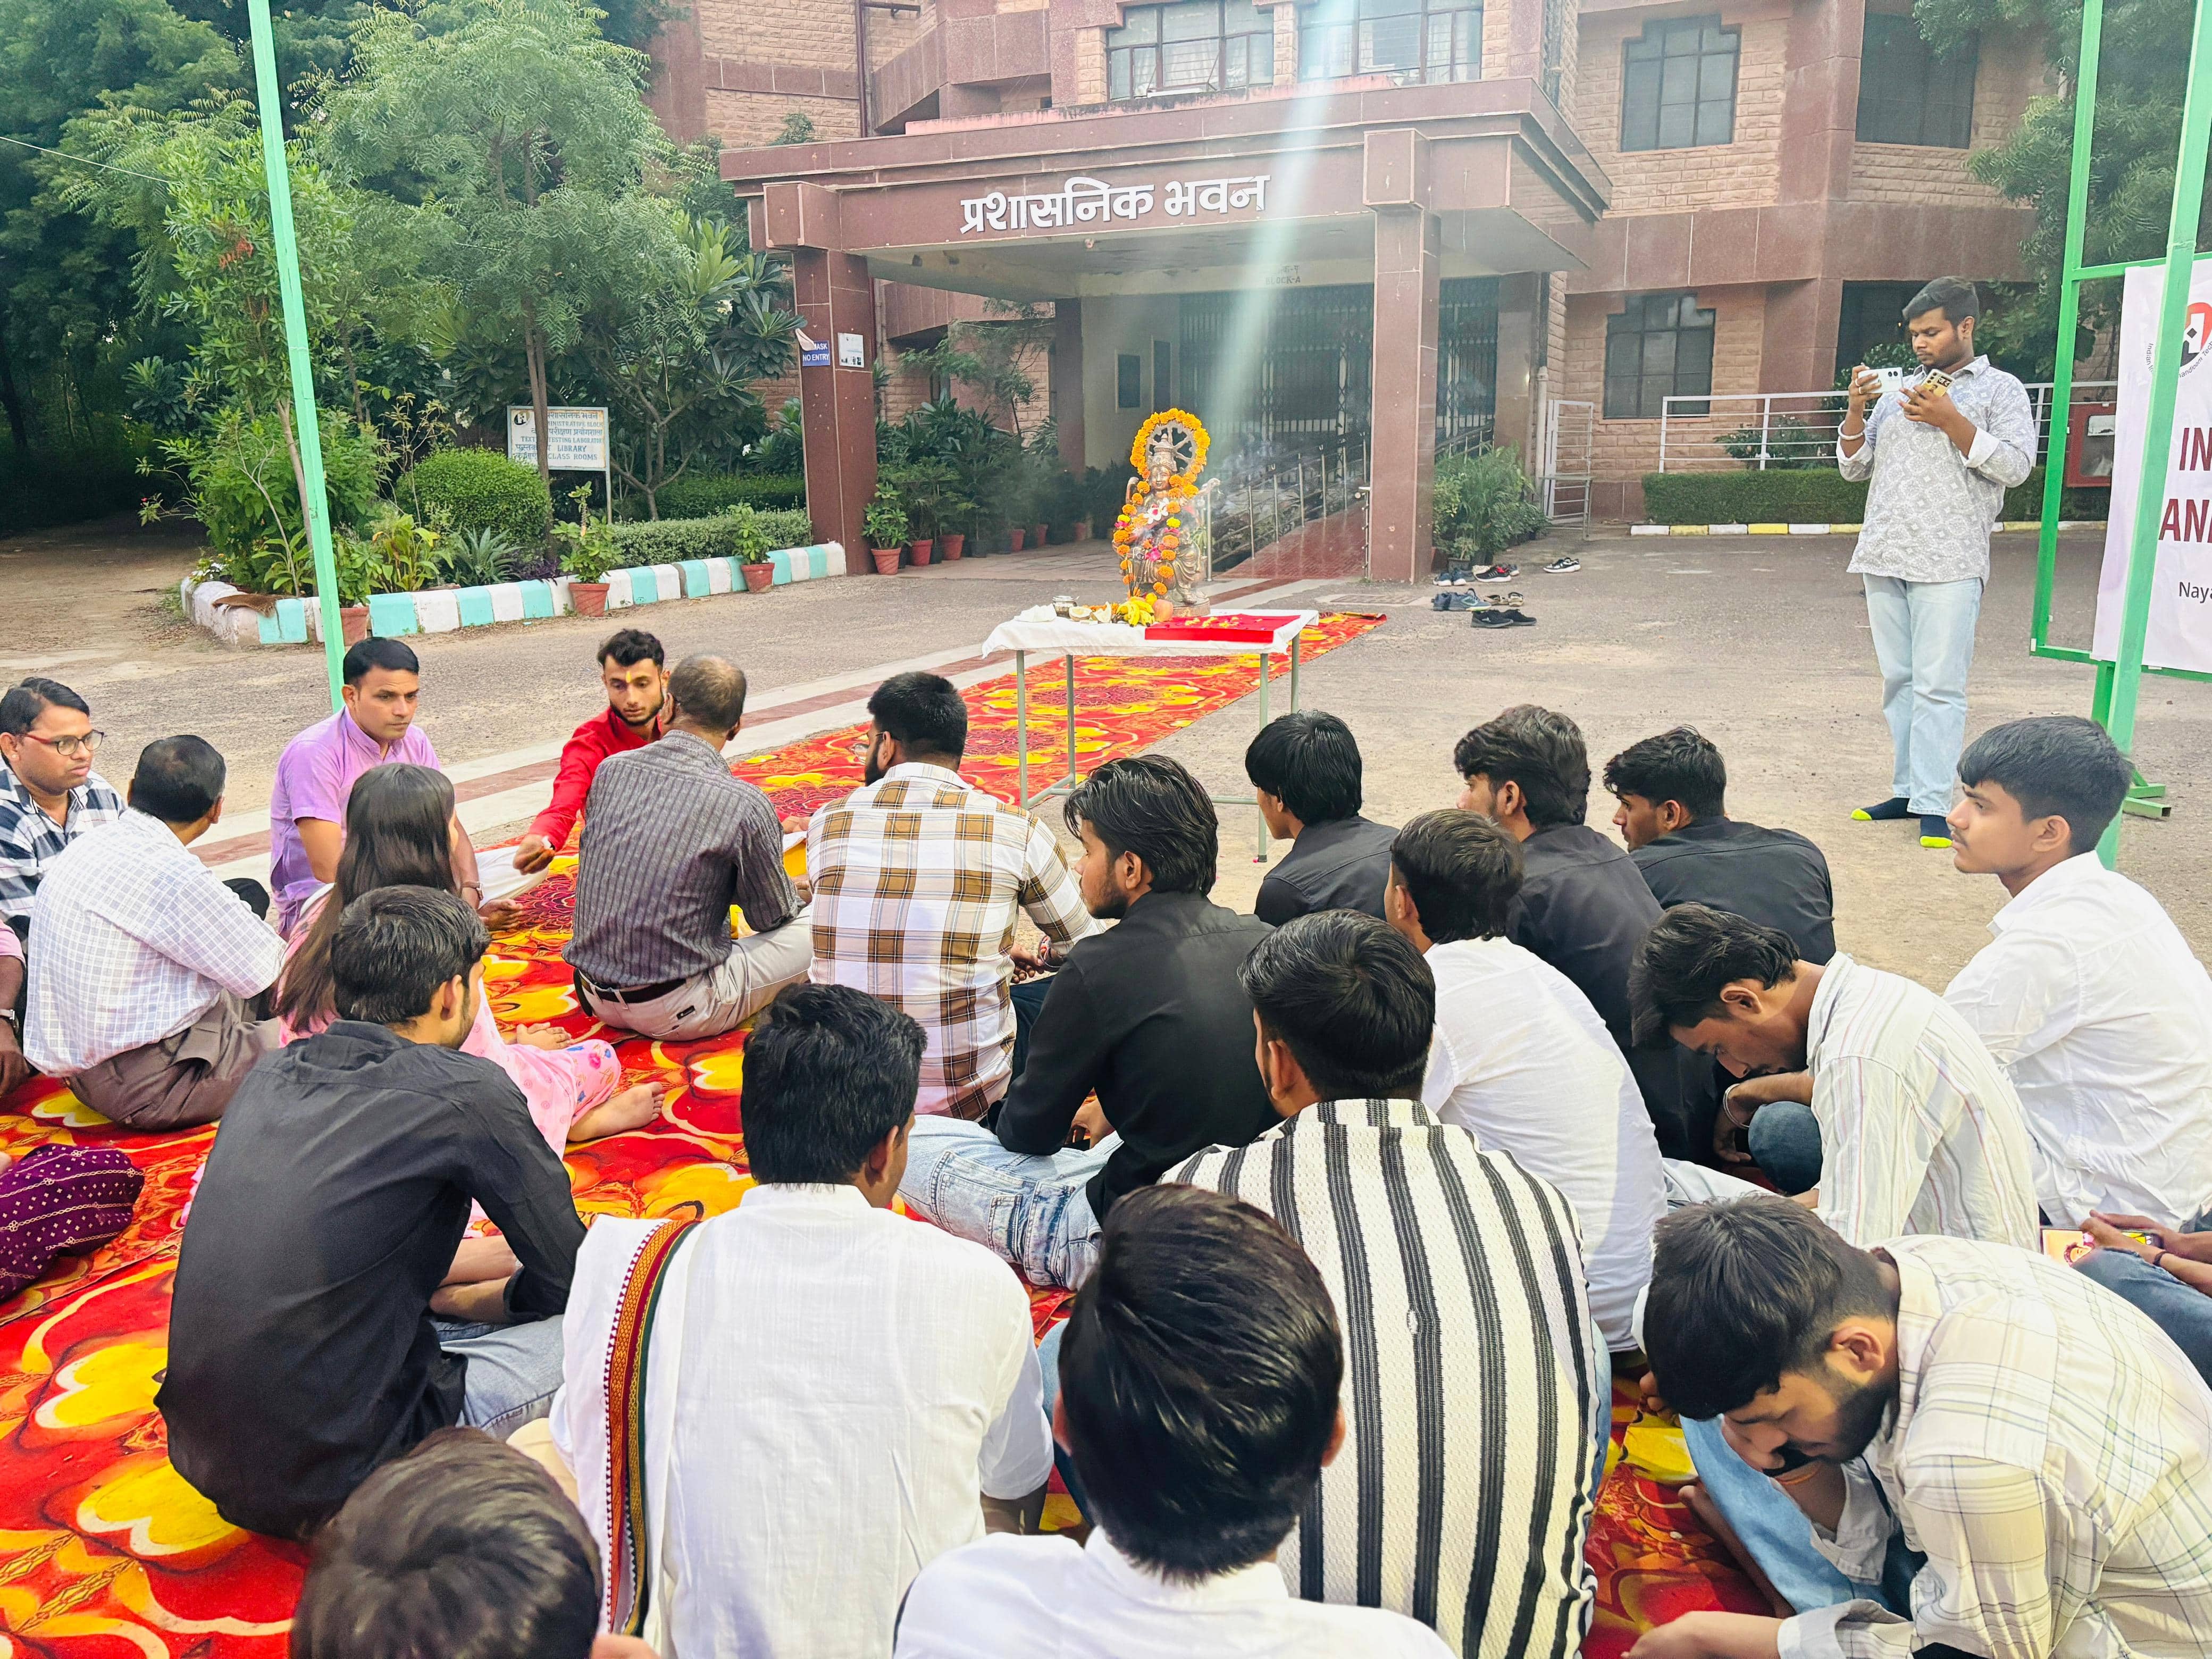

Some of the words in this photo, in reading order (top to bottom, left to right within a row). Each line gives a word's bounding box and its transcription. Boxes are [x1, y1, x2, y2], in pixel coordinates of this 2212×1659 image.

[960, 176, 1155, 234] प्रशासनिक
[1164, 175, 1271, 216] भवन
[1266, 276, 1301, 285] BLOCK-A
[2158, 499, 2212, 543] AN
